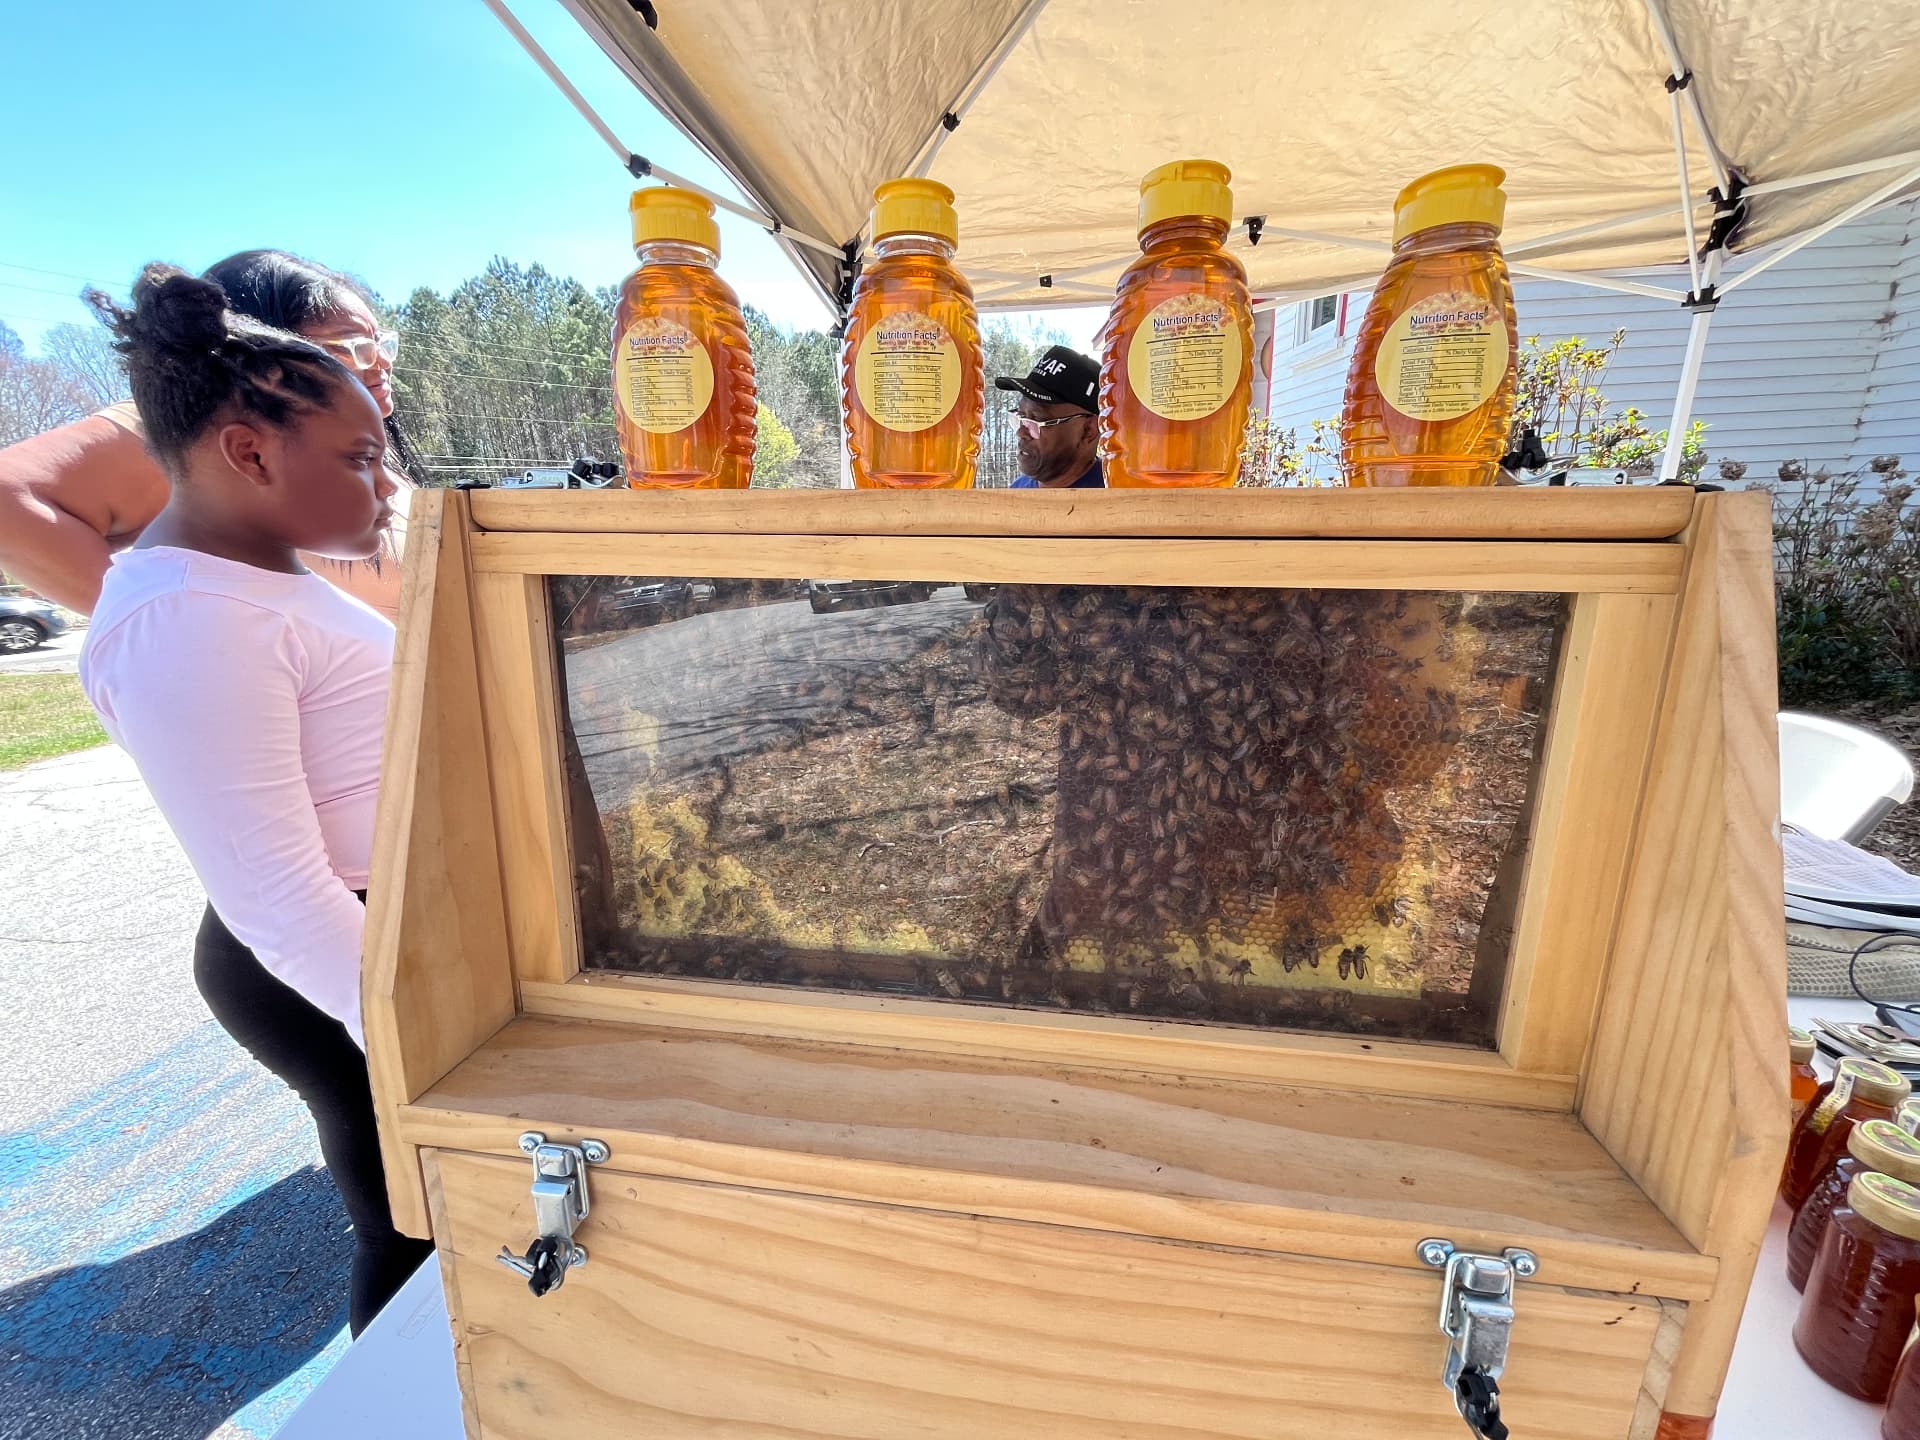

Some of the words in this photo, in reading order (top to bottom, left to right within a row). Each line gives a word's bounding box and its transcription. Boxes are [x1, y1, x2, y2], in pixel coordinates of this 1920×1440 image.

[1153, 315, 1193, 328] Nutrition
[1194, 312, 1219, 323] Facts
[1410, 312, 1455, 325] Nutrition
[1457, 311, 1484, 321] Facts
[630, 336, 661, 346] Nutrition
[661, 335, 685, 344] Facts
[877, 330, 913, 340] Nutrition
[914, 329, 937, 340] Facts
